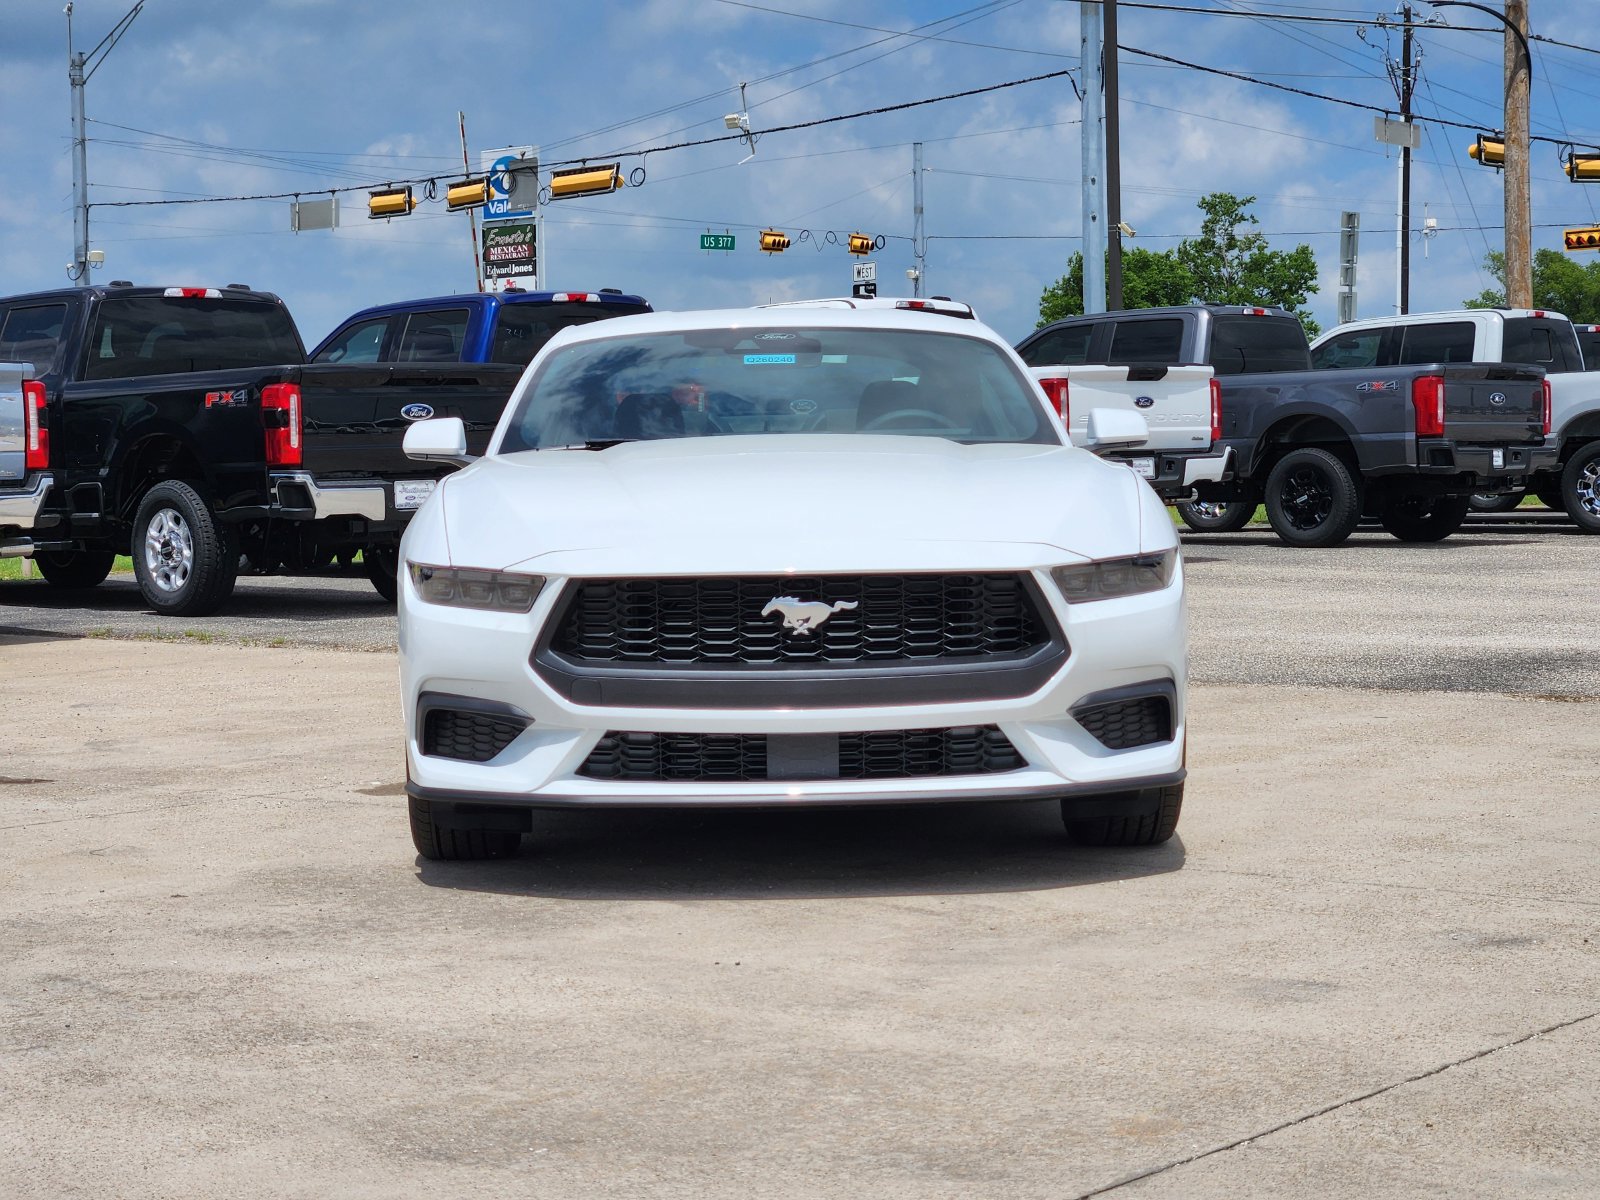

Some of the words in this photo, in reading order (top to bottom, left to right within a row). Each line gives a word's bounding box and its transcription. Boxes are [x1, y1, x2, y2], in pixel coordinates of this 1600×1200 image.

[488, 200, 512, 214] Val
[704, 236, 715, 247] US
[718, 237, 732, 248] 377
[490, 244, 528, 254] MEXICAN
[490, 251, 529, 260] RESTAURANT
[856, 266, 873, 279] WEST
[204, 389, 248, 409] FX4
